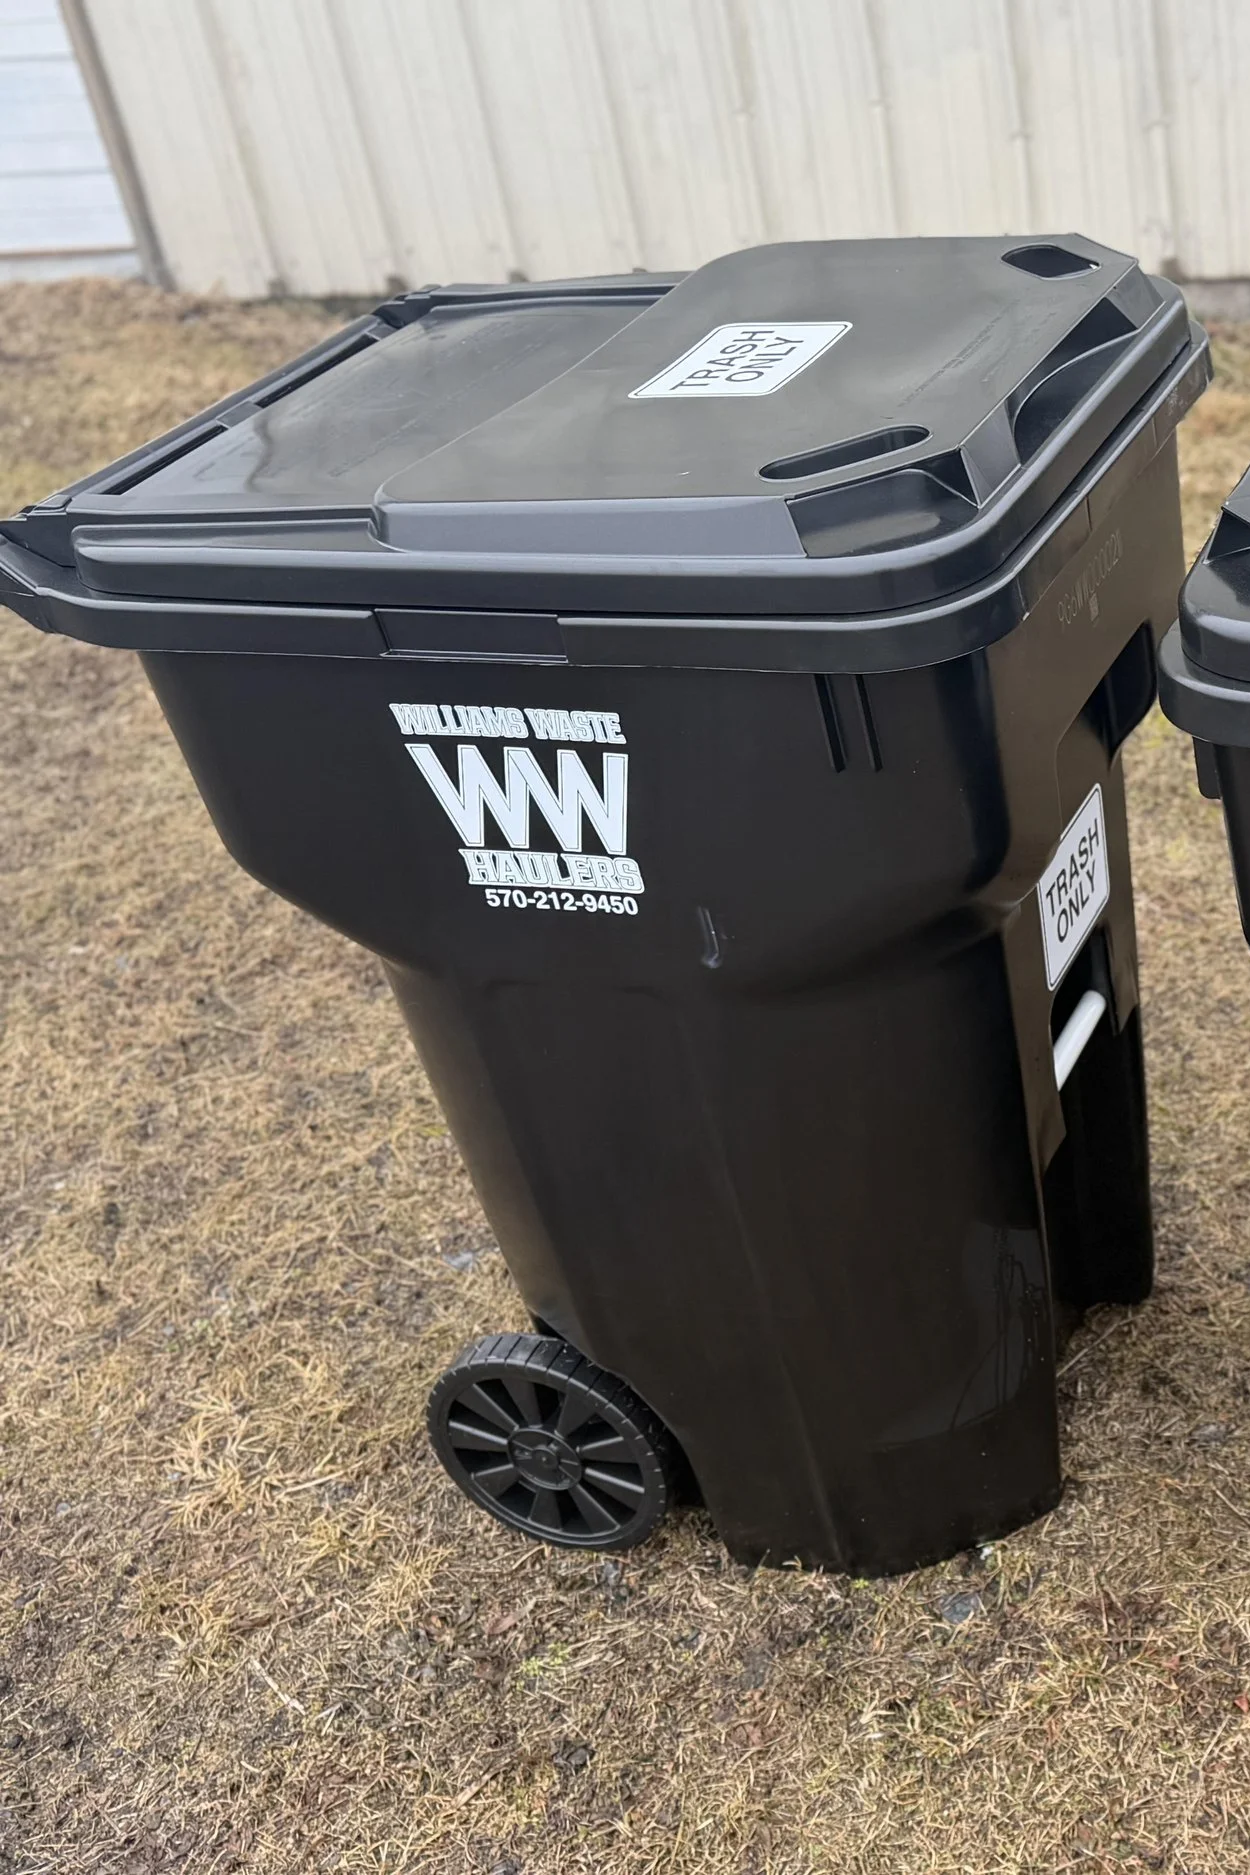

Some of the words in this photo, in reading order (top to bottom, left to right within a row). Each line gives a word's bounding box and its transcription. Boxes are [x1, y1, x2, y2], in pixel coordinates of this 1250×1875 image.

[669, 330, 776, 391] TRASH
[724, 336, 805, 383] ONLY
[388, 703, 529, 739] WILLIAMS
[523, 707, 627, 745] WASTE
[404, 743, 629, 856] WW
[458, 848, 645, 895] HAULERS
[1045, 817, 1100, 918] TRASH
[484, 888, 639, 916] 570-212-9450
[1056, 859, 1096, 943] ONLY
